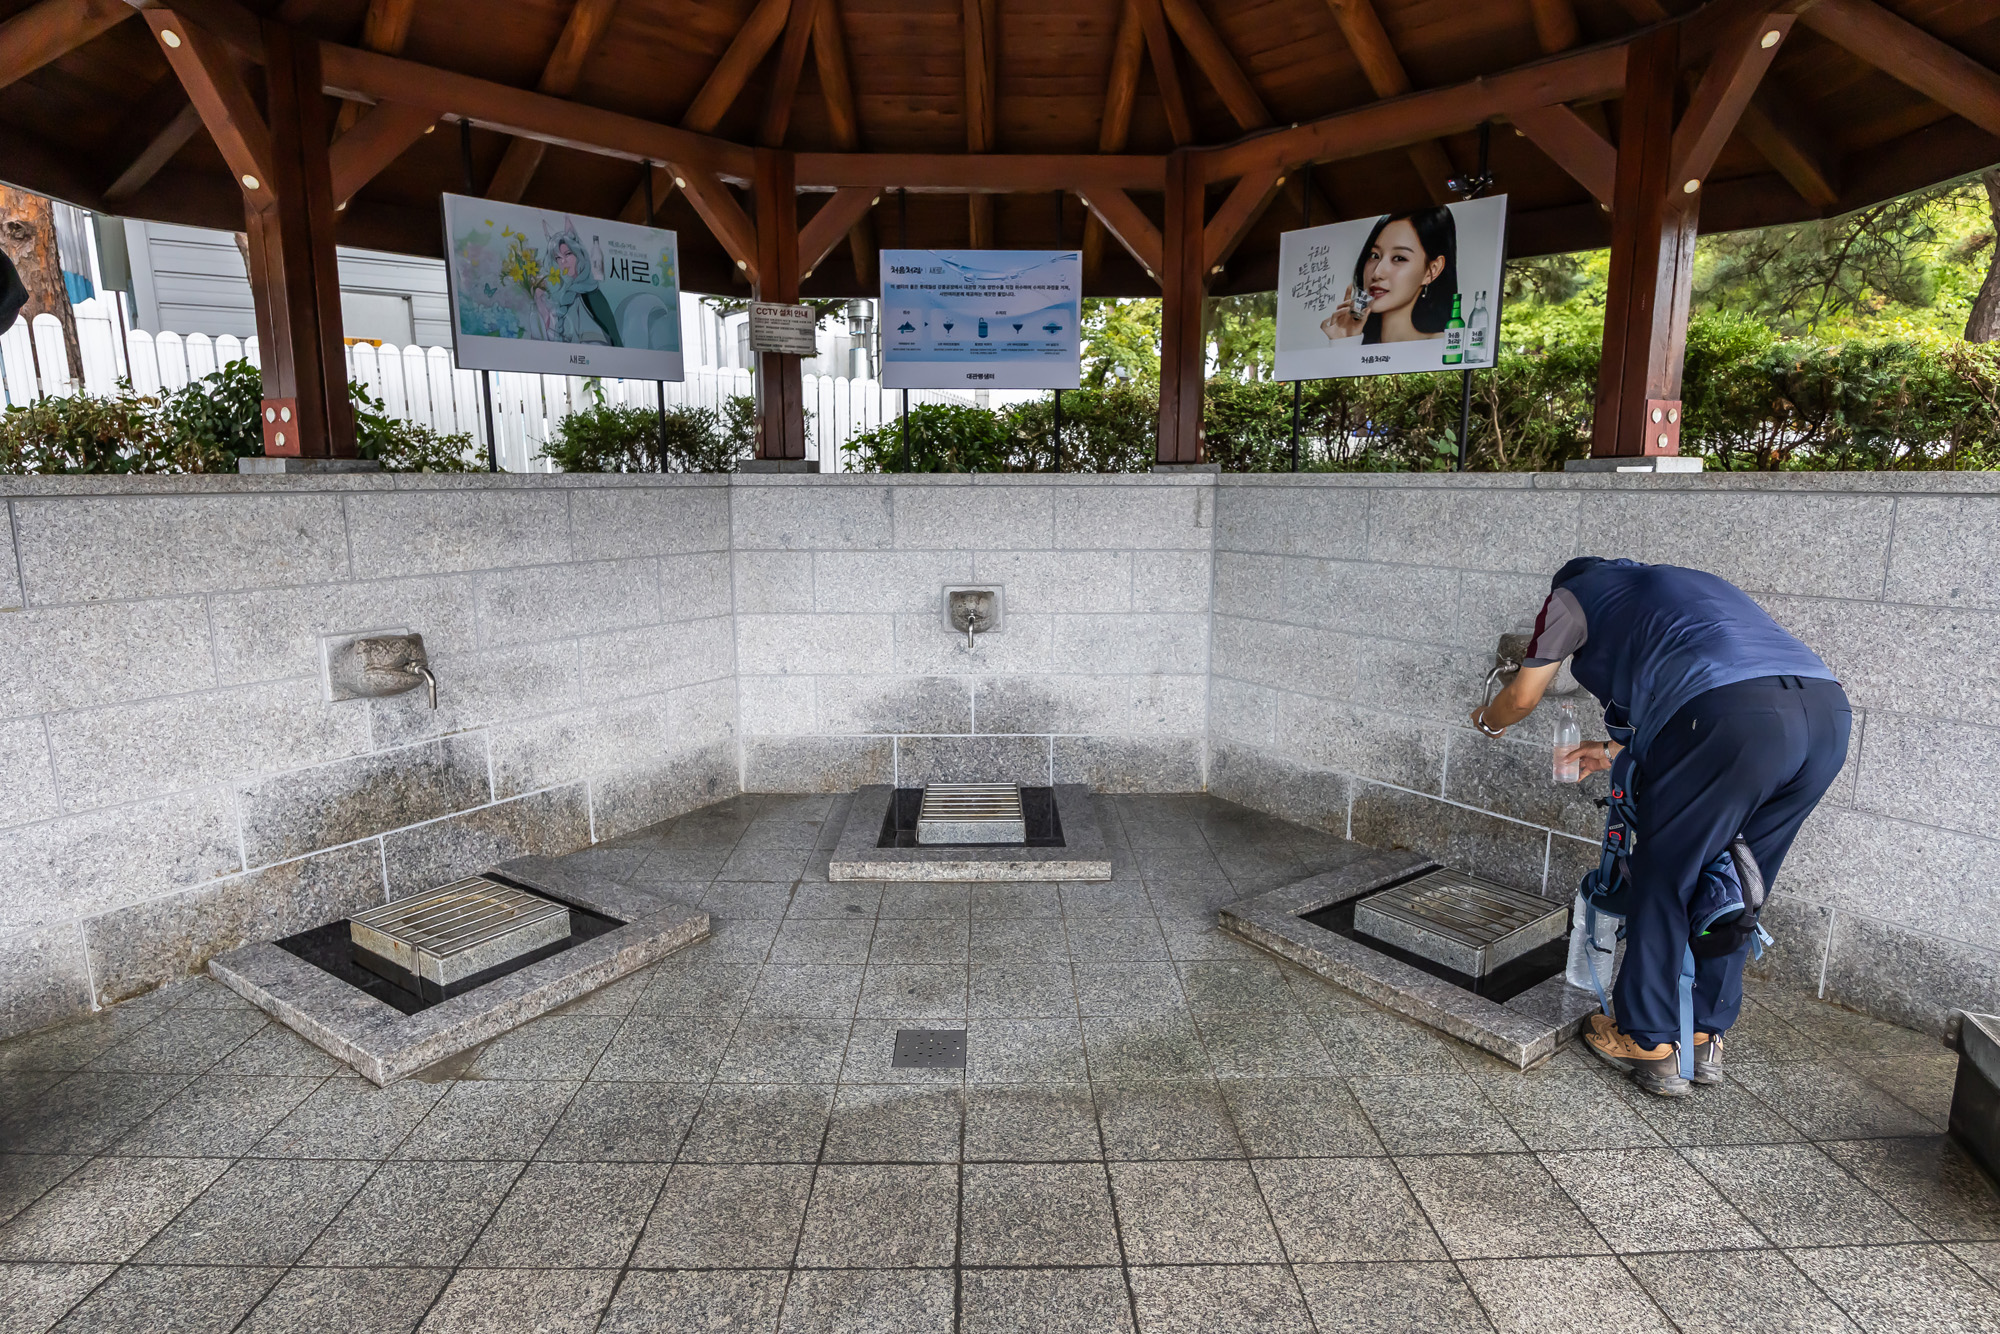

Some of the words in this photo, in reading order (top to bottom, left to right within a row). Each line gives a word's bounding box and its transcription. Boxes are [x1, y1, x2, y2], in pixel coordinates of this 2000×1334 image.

[610, 257, 651, 284] 새로
[890, 266, 923, 274] 처음처럼
[756, 307, 778, 316] CCTV
[780, 309, 793, 317] 설치
[794, 310, 808, 318] 안내
[569, 355, 586, 365] 새로
[1361, 355, 1391, 364] 처음처럼
